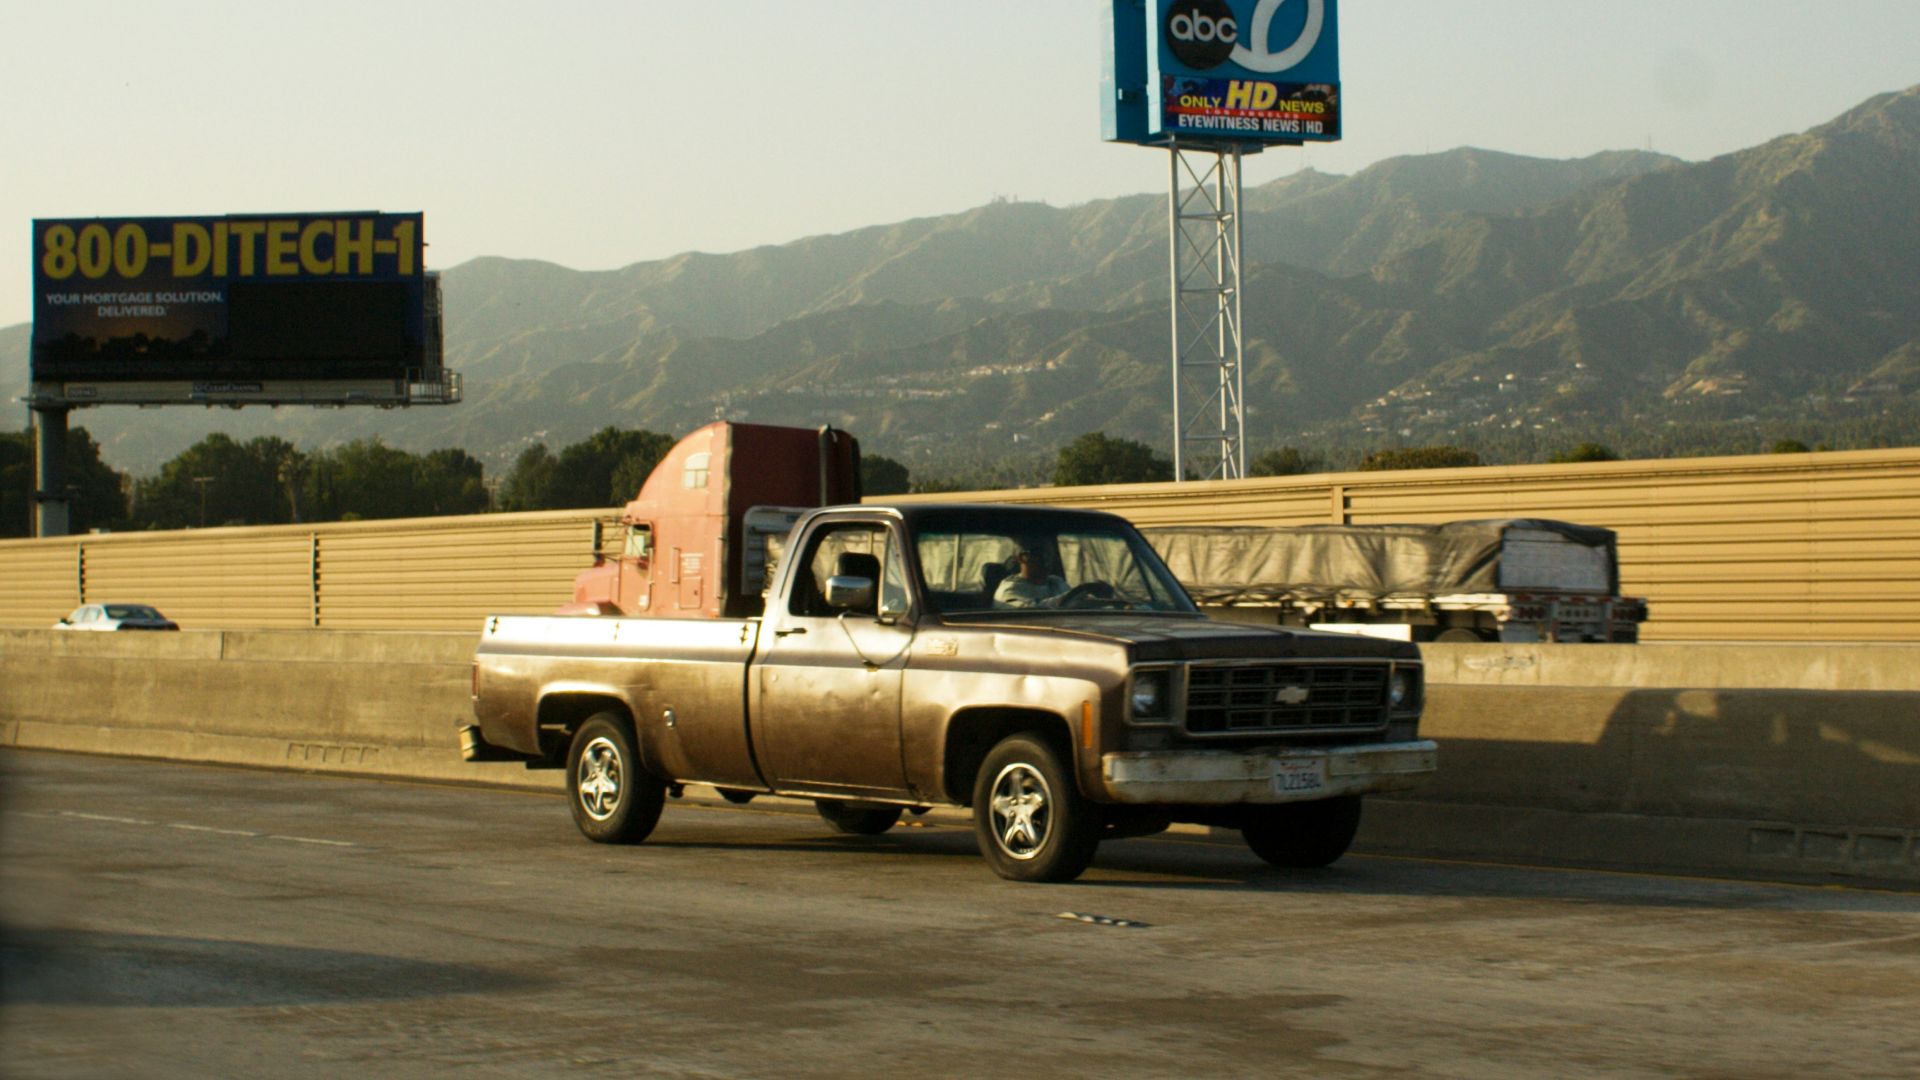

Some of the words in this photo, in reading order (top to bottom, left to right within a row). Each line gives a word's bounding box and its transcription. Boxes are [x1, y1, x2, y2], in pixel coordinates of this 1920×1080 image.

[1170, 8, 1237, 43] abc
[1180, 95, 1221, 108] ONLY
[1225, 80, 1277, 110] HD
[1280, 100, 1325, 114] NEWS
[1178, 114, 1260, 131] EYEWITNESS
[1263, 118, 1300, 133] NEWS
[1306, 121, 1324, 134] HD
[42, 219, 414, 279] 800-DITECH-1
[46, 292, 80, 305] YOUR
[83, 292, 152, 304] MORTGAGE
